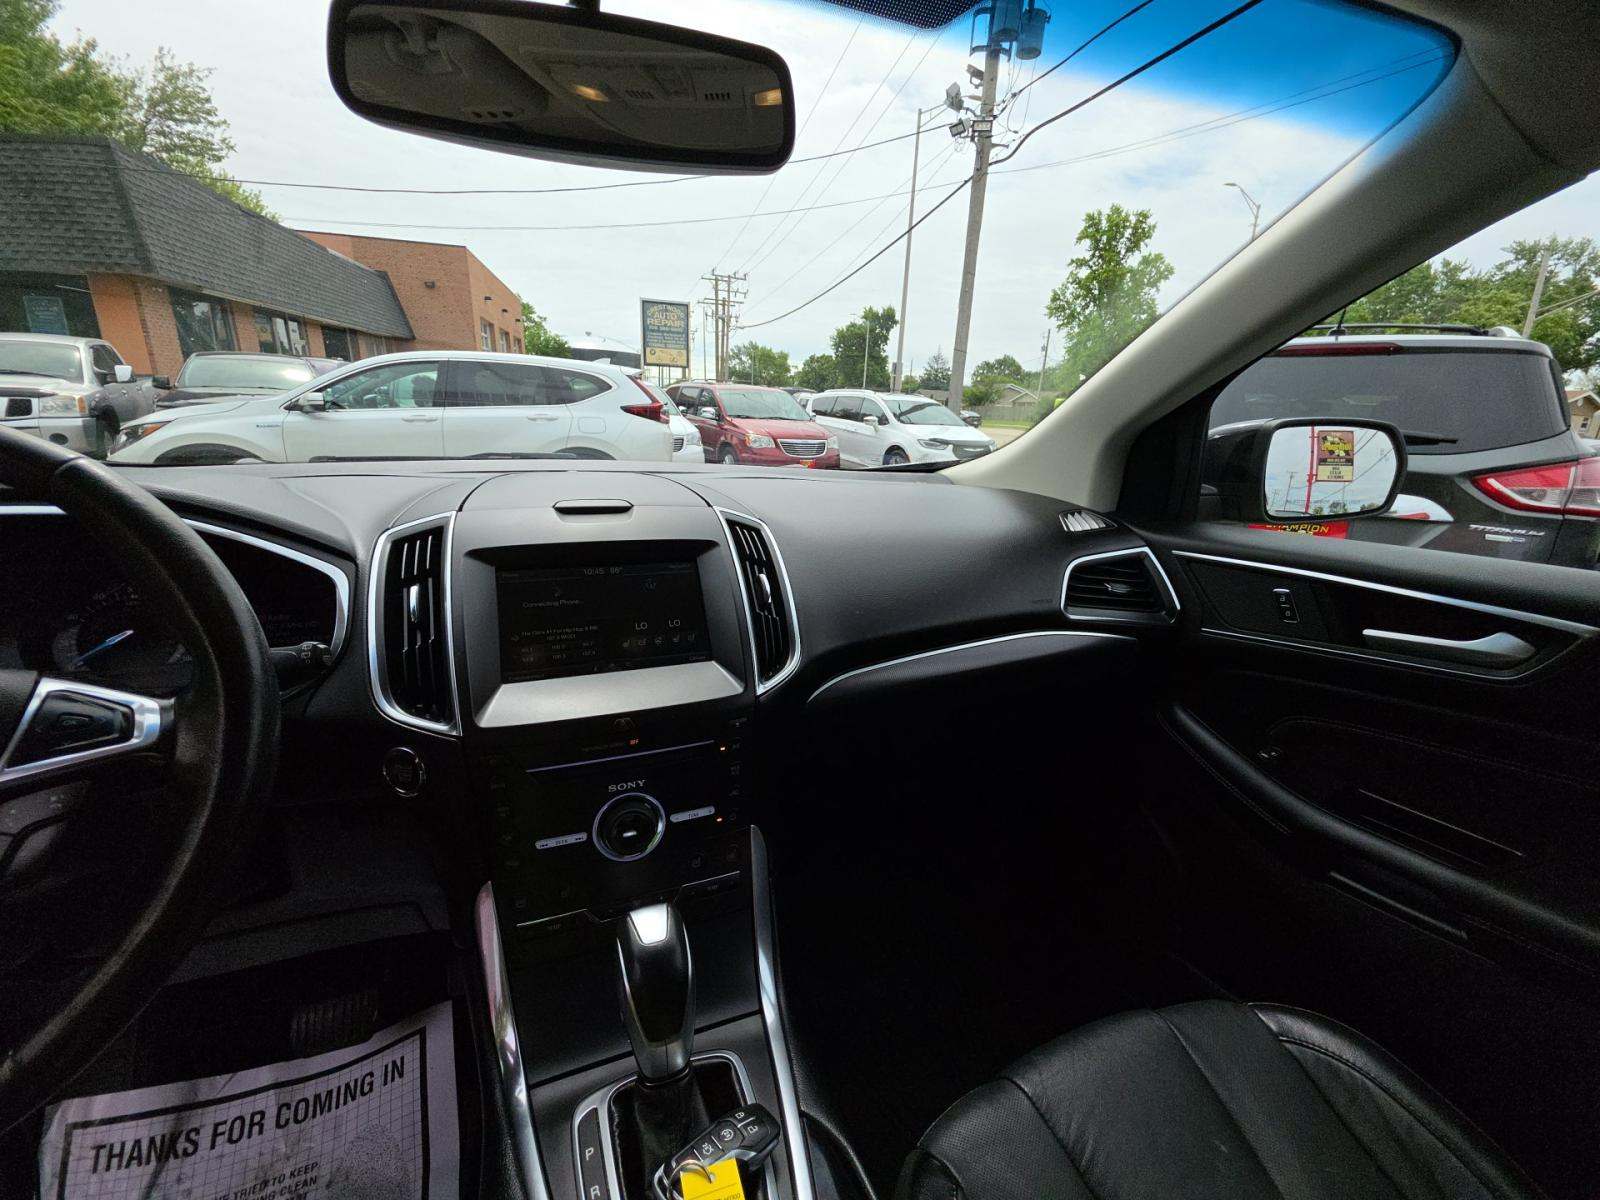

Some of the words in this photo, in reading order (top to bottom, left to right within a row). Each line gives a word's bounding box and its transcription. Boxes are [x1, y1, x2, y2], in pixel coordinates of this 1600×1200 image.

[654, 311, 678, 320] AUTO
[647, 318, 685, 328] REPAIR
[634, 621, 648, 631] LO
[668, 617, 681, 628] LO
[608, 779, 646, 792] SONY
[91, 1127, 200, 1174] THANKS
[210, 1110, 266, 1151] FOR
[276, 1071, 375, 1130] COMING
[383, 1056, 405, 1086] IN
[585, 1147, 594, 1160] P
[272, 1174, 286, 1187] TO
[289, 1161, 319, 1180] KEEP
[280, 1176, 318, 1198] CLEAN
[590, 1184, 601, 1200] R
